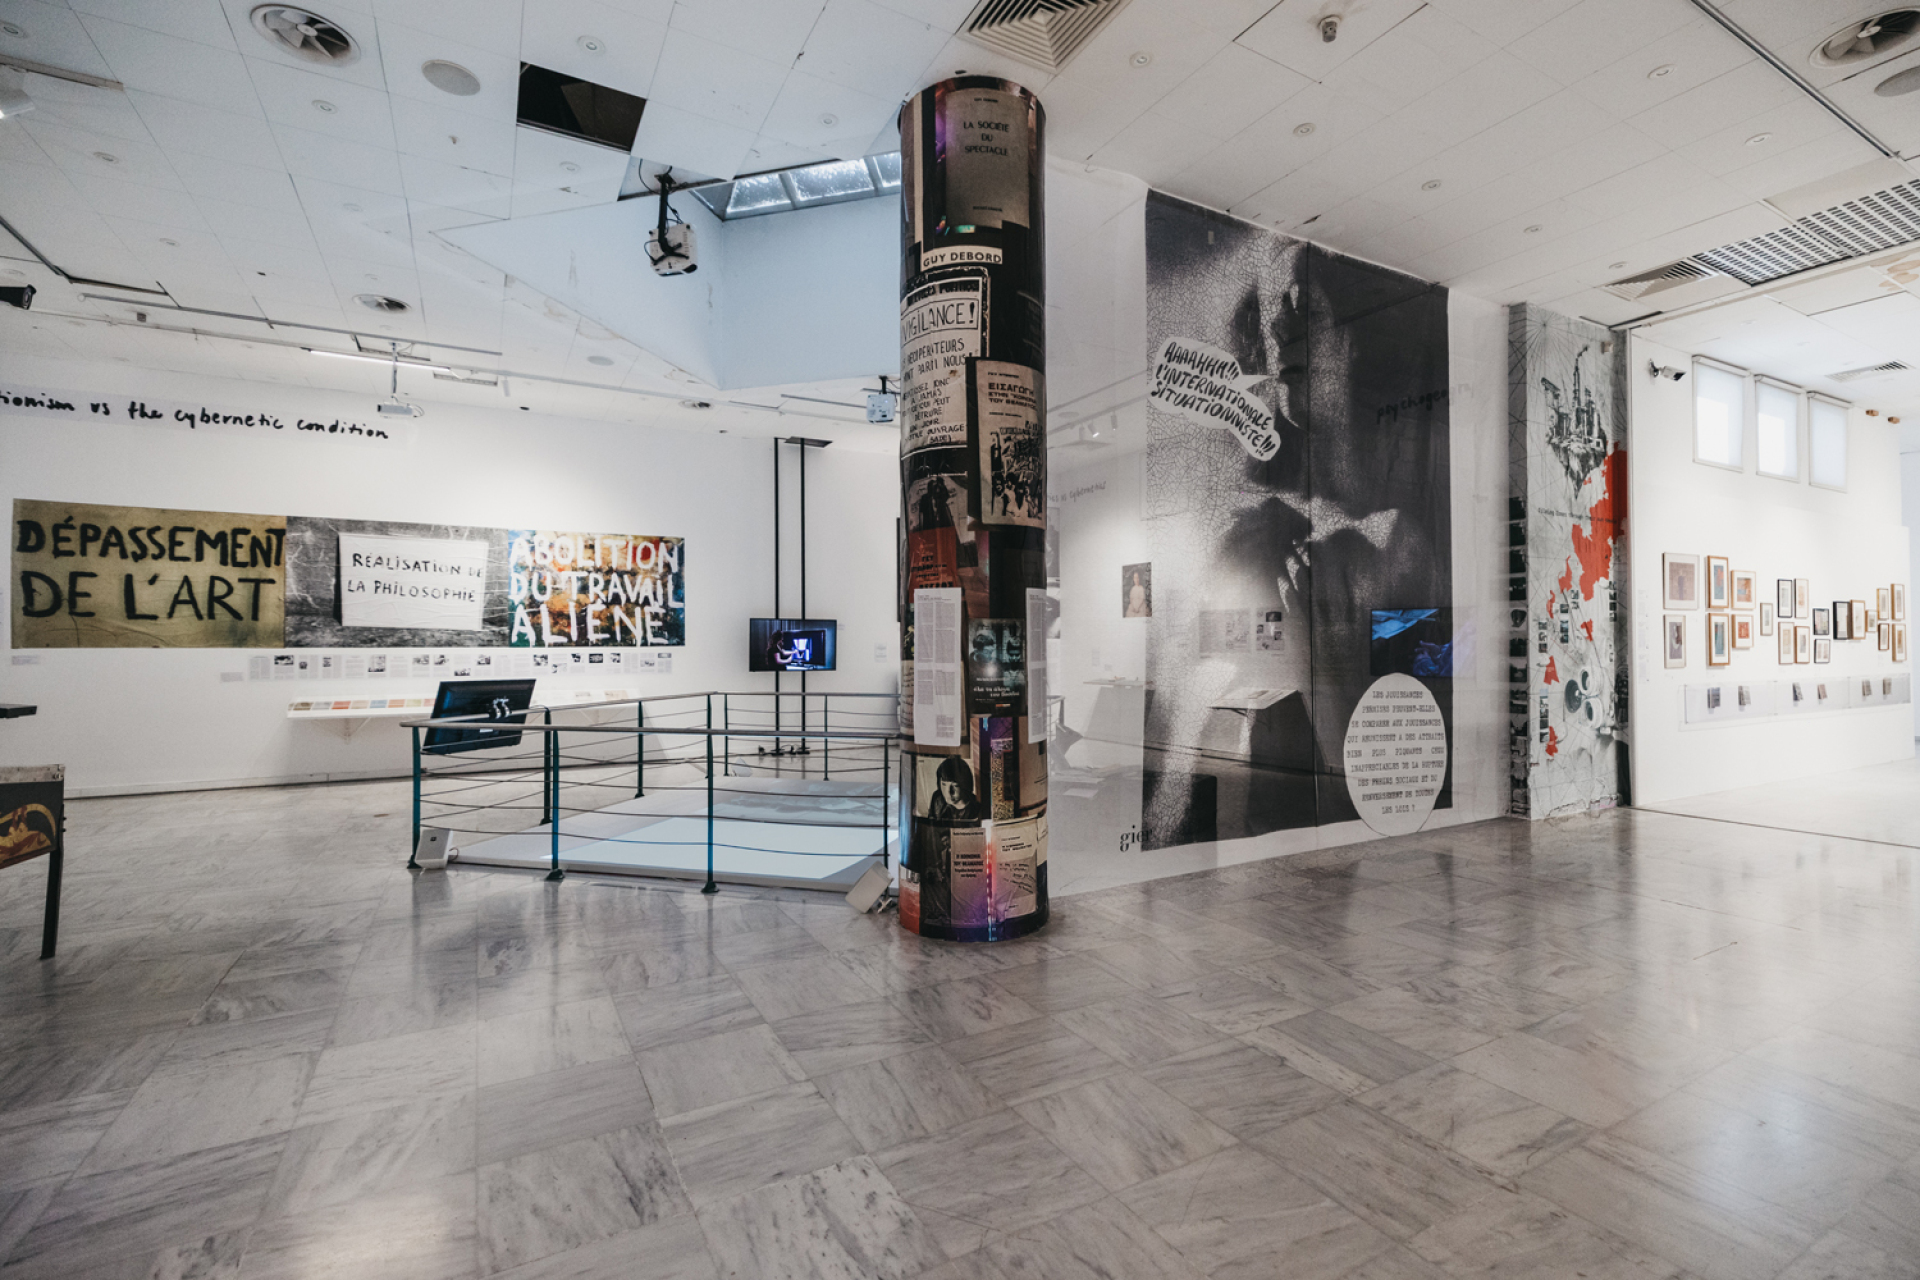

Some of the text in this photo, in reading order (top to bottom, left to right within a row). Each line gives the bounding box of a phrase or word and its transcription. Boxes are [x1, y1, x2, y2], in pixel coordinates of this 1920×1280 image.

[963, 121, 974, 130] LA
[981, 132, 993, 142] DU
[923, 251, 1002, 268] GUY DEBORD
[90, 402, 110, 416] vs
[128, 400, 163, 420] the
[174, 406, 284, 430] cybernetic
[296, 419, 389, 440] condition
[16, 515, 286, 568] DÉPASSEMENT
[509, 533, 679, 573] ABOLITION
[21, 570, 98, 618] DE
[124, 572, 276, 621] L'ART
[347, 580, 366, 593] LA
[508, 570, 684, 608] DU TRAVAIL
